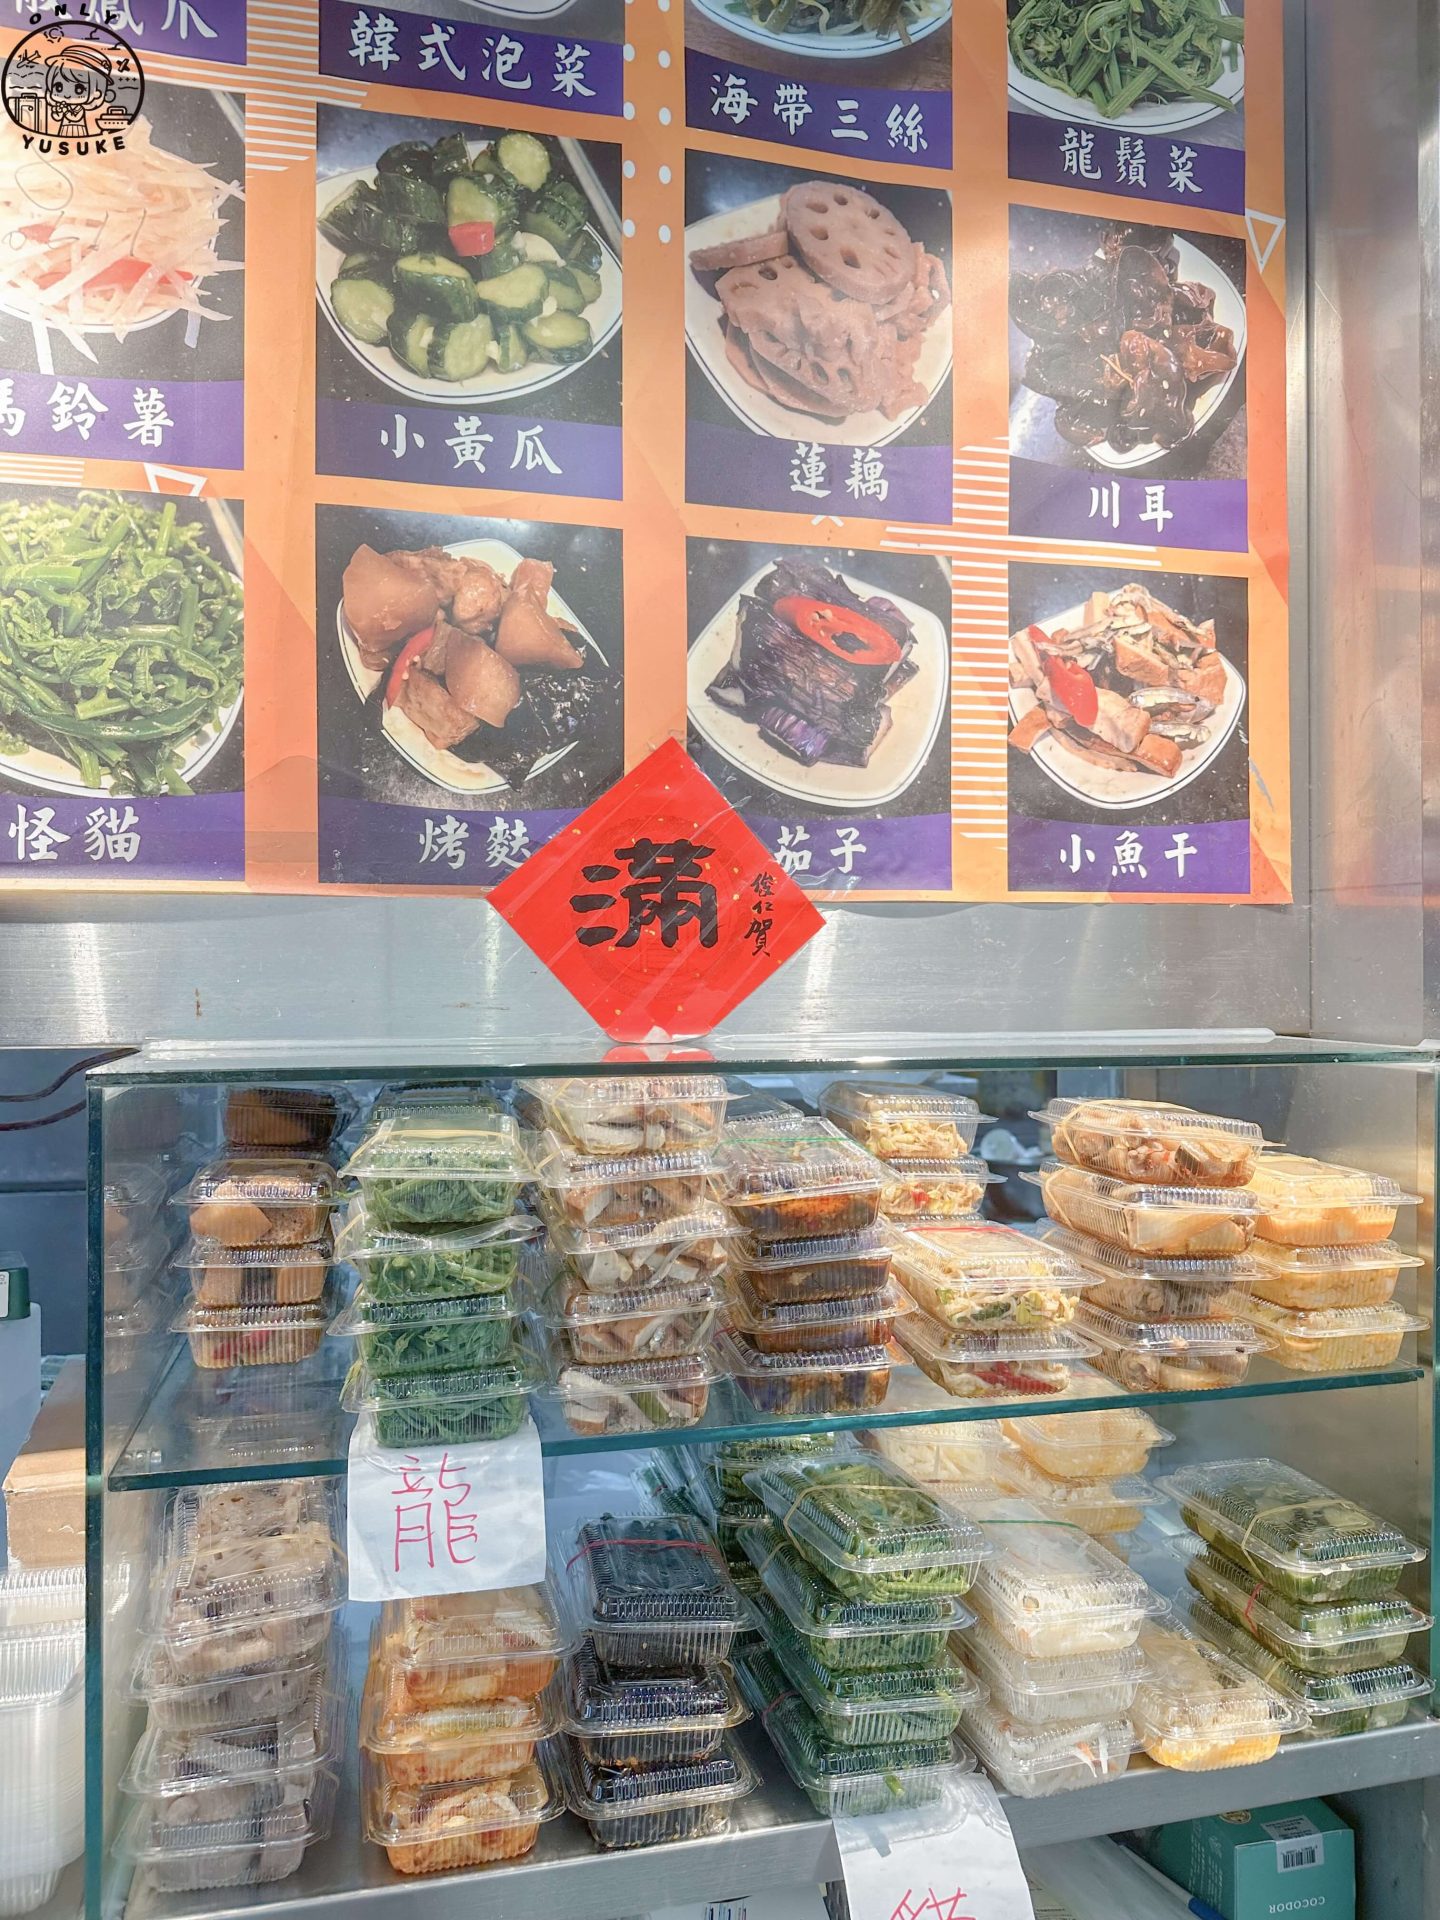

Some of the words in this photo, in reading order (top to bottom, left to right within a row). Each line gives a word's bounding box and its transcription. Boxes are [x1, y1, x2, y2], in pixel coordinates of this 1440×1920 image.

[348, 10, 597, 97] 韓式泡菜
[710, 73, 928, 153] 海帶三絲
[1059, 127, 1203, 193] 龍鬚菜
[380, 413, 563, 474] 小黃瓜
[789, 441, 889, 502] 蓮藕
[1088, 480, 1174, 533] 川耳
[8, 803, 141, 862] 怪貓
[418, 814, 531, 870] 烤麩
[773, 825, 867, 874] 茄子
[1060, 830, 1198, 879] 小魚干
[391, 1452, 478, 1572] 龍
[1269, 1896, 1326, 1914] COCODOR
